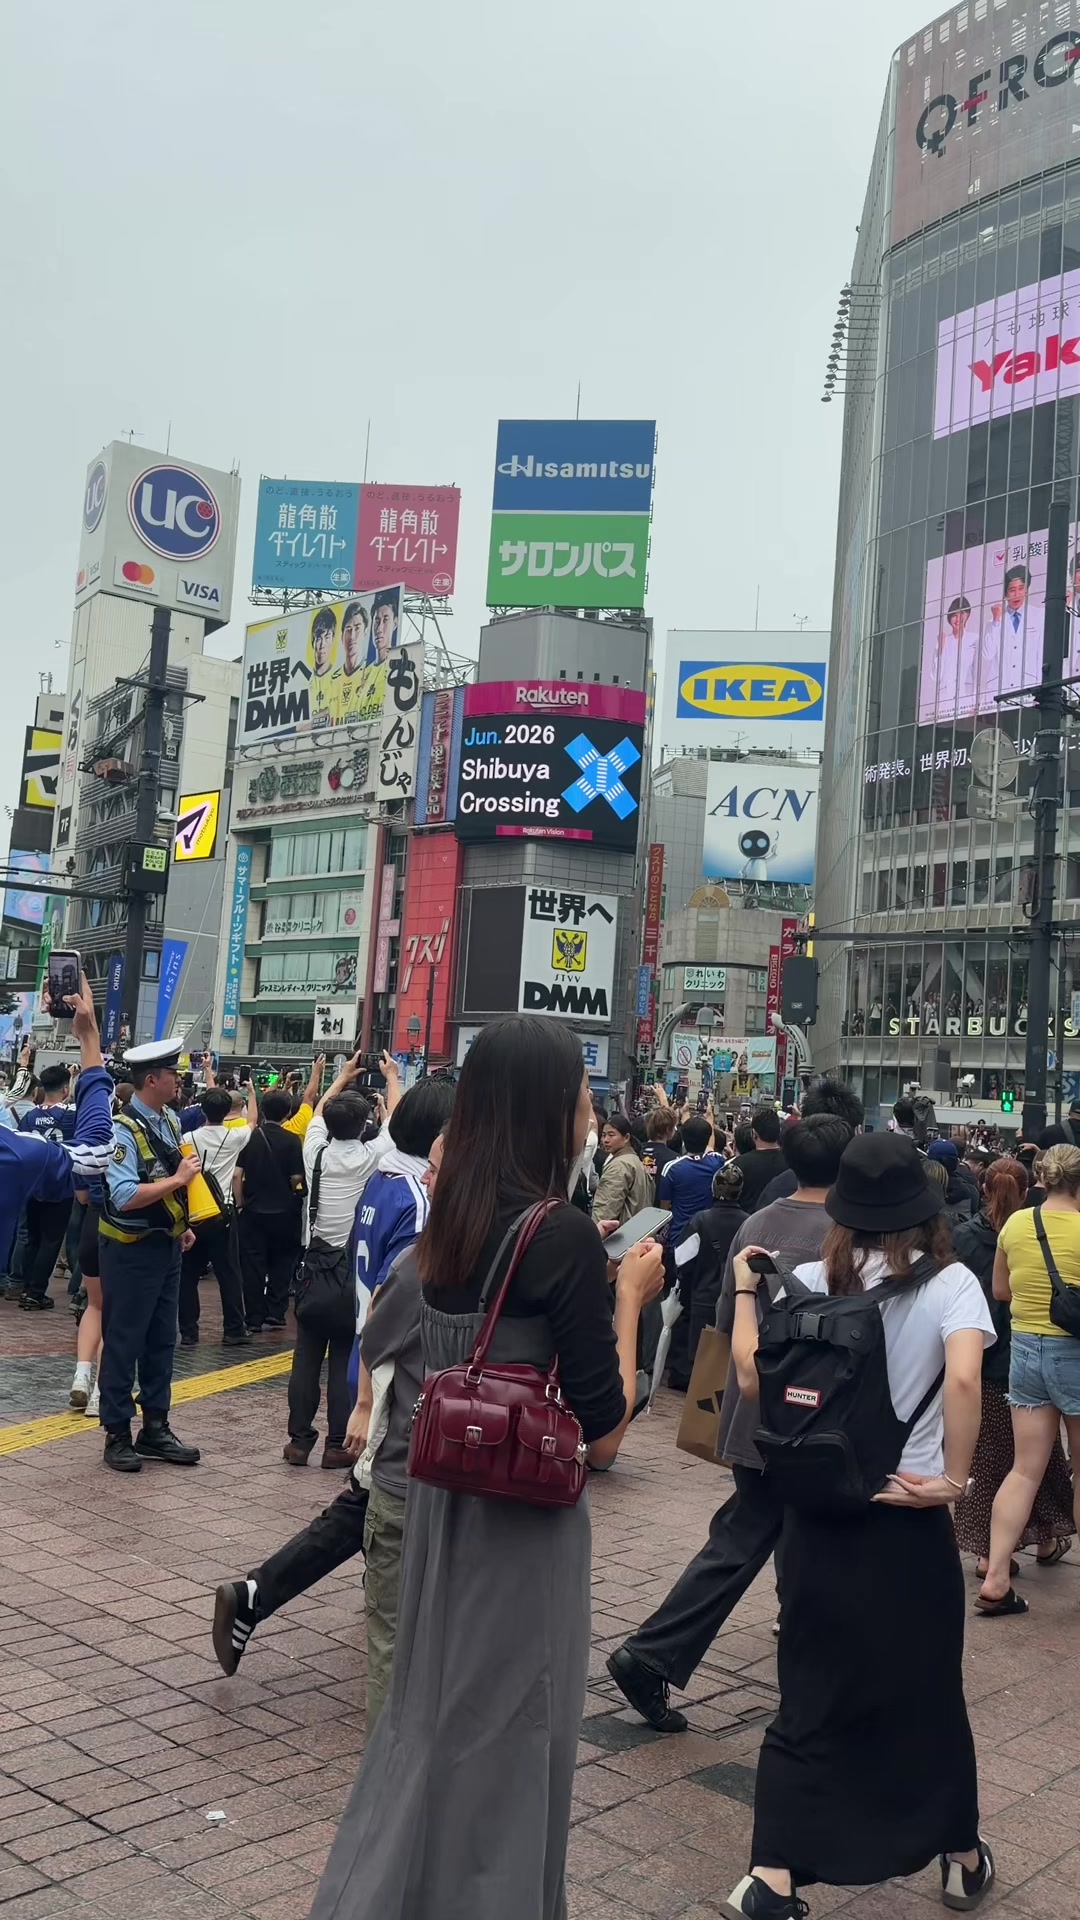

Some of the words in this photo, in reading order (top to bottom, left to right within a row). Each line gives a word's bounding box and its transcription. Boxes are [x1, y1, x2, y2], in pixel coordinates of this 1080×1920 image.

[497, 454, 651, 479] Hisamitsu
[278, 503, 338, 530] 龍角散
[379, 508, 439, 535] 龍角散
[499, 540, 636, 579] サロンパス
[181, 579, 220, 602] VISA
[247, 657, 313, 699] 世界へ
[693, 678, 812, 702] IKEA
[515, 685, 589, 707] Rakuten
[244, 689, 310, 732] DMM
[379, 647, 419, 795] もんじゃ
[464, 727, 502, 747] Jun.
[504, 724, 556, 745] 2026
[461, 759, 551, 784] Shibuya
[459, 791, 561, 819] Crossing
[707, 785, 816, 822] ACN
[60, 816, 70, 833] 7F
[522, 826, 544, 836] Rakuten
[545, 826, 565, 836] Vision
[648, 847, 661, 921] クスリのことなら
[231, 865, 247, 965] サマーフルーツギフト
[528, 889, 614, 925] 世界へ
[113, 963, 121, 991] MIZUHO
[554, 973, 581, 983] STVV
[685, 979, 725, 988] クリニック
[695, 969, 725, 978] れいわ
[523, 980, 609, 1017] DMM
[787, 1391, 817, 1401] HUNTER
